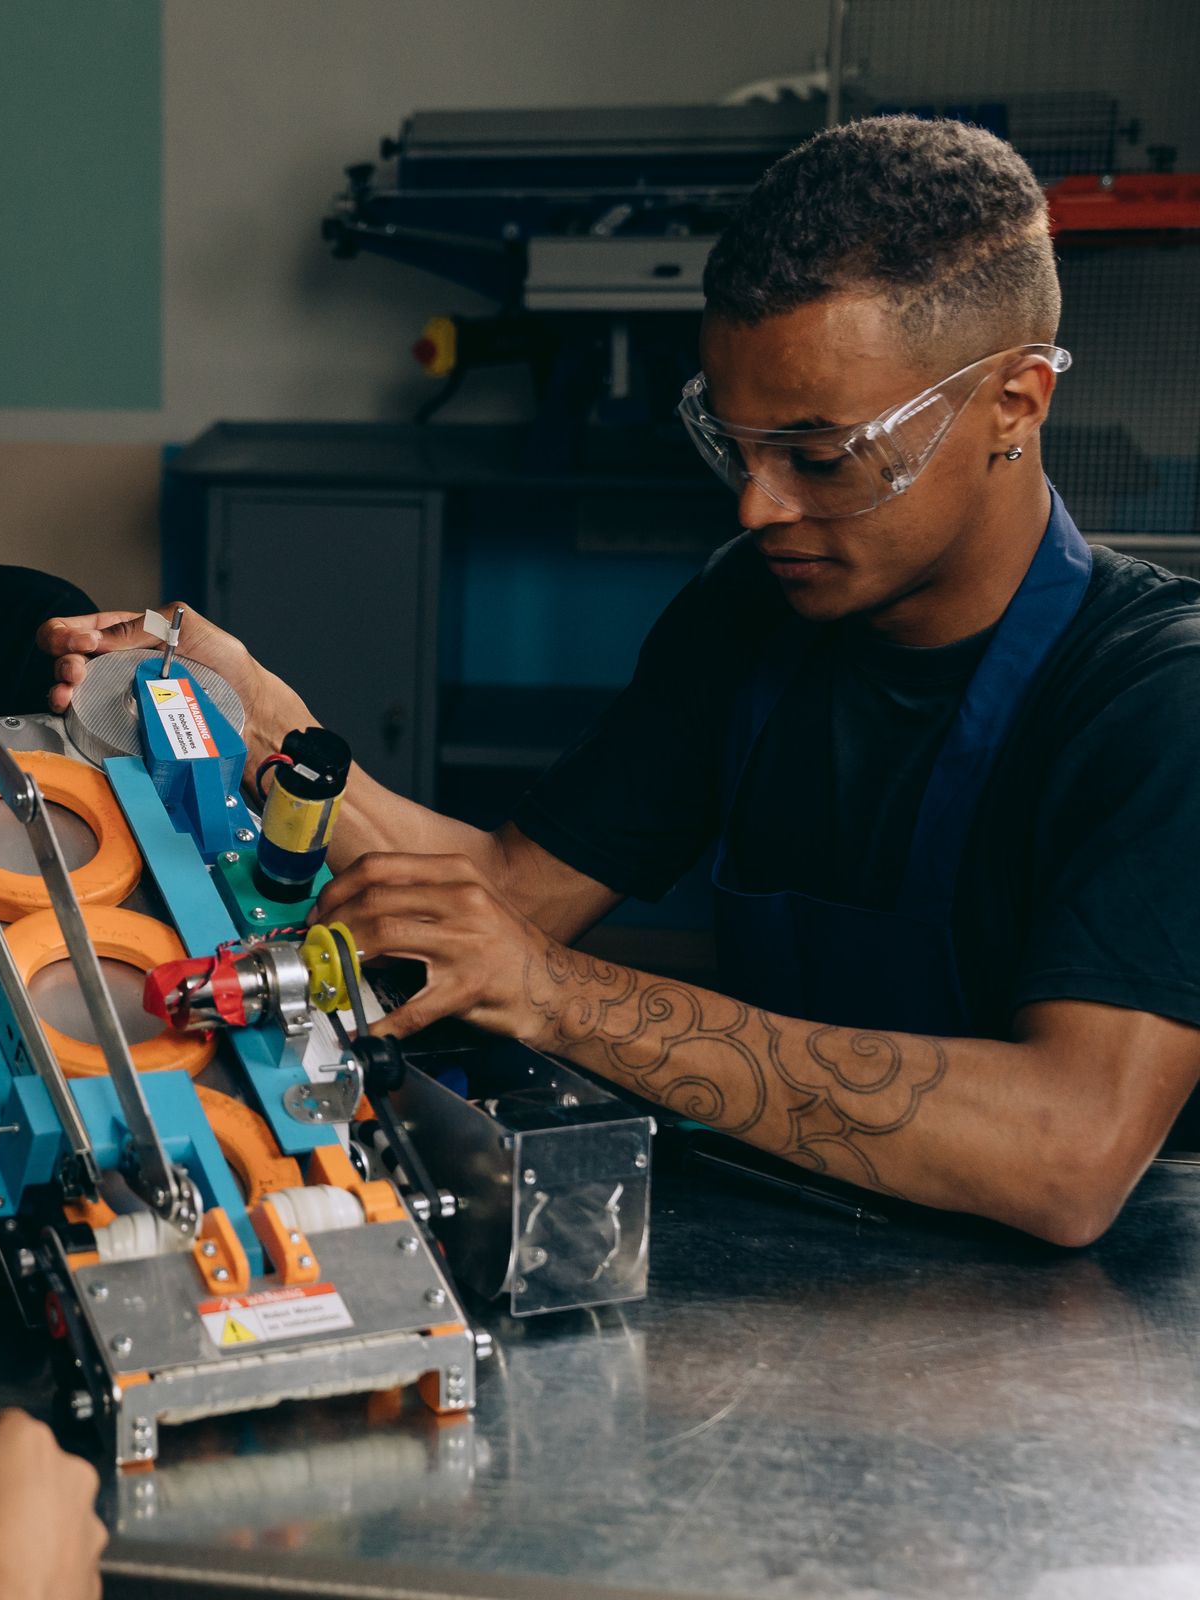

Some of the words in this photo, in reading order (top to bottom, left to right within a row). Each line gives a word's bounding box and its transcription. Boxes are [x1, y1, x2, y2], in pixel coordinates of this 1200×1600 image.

[168, 714, 175, 722] on
[178, 713, 189, 731] Robot
[186, 731, 197, 749] Moves
[189, 702, 210, 740] WARNING
